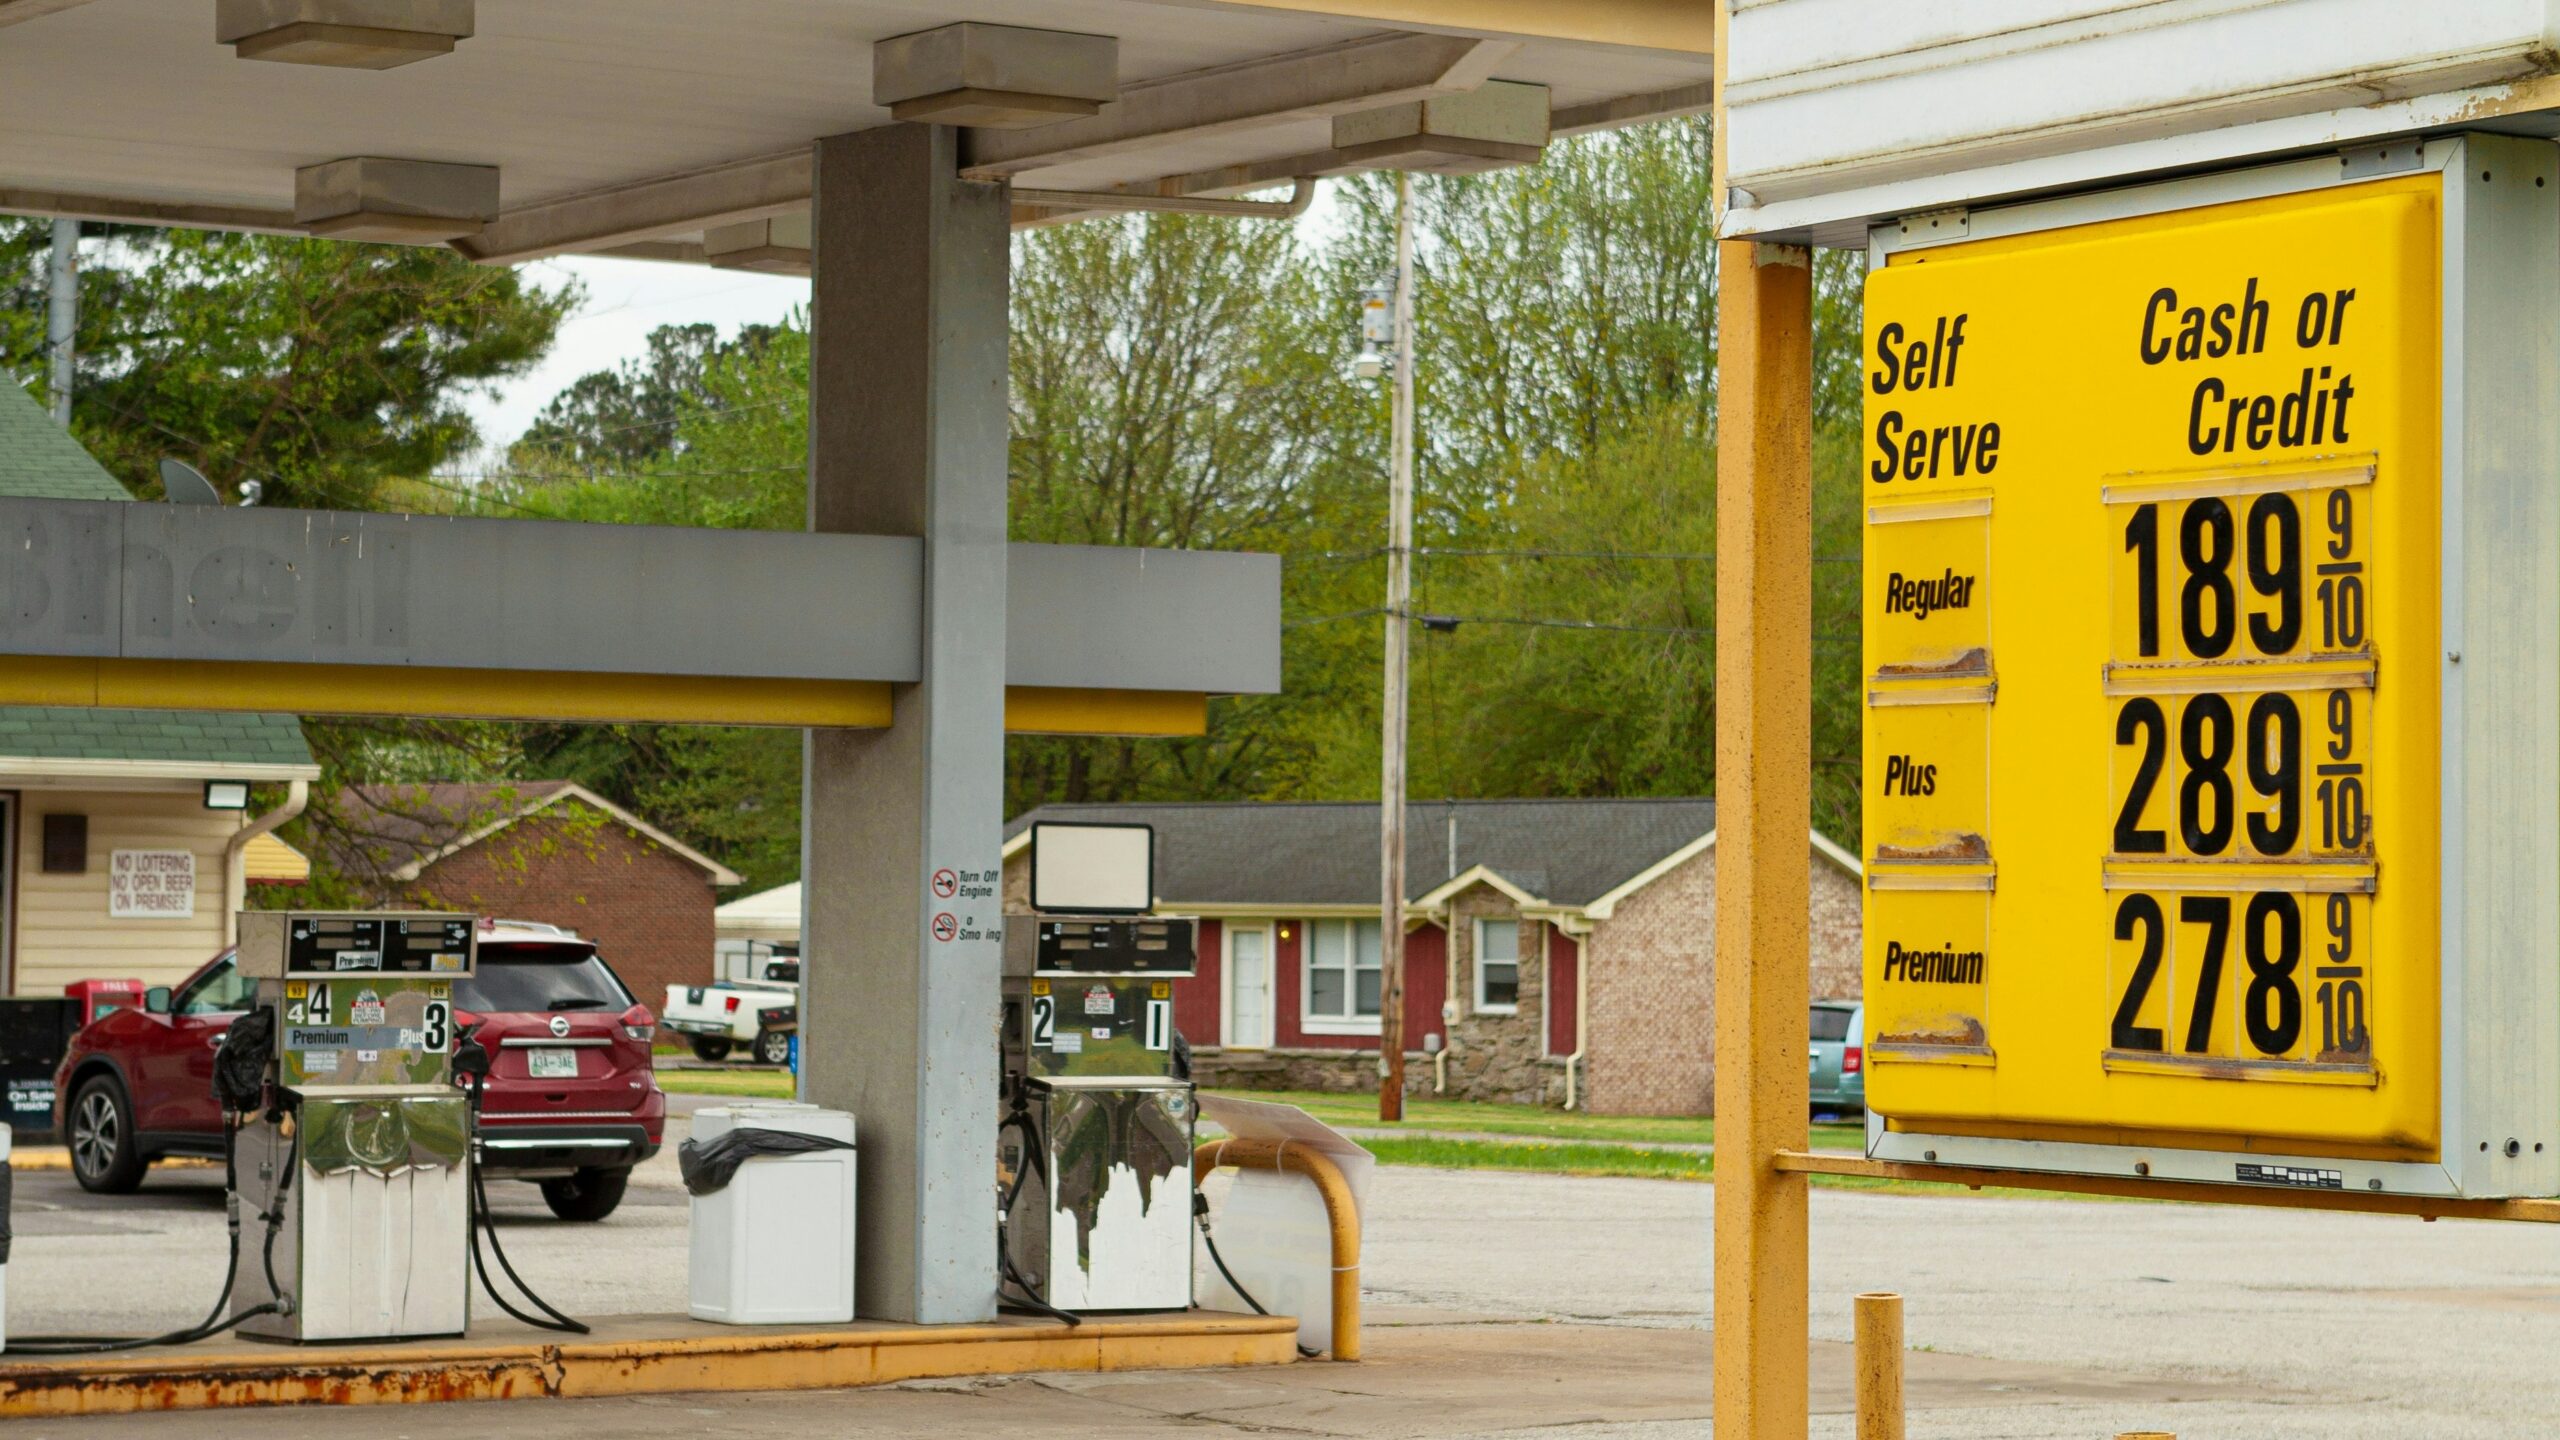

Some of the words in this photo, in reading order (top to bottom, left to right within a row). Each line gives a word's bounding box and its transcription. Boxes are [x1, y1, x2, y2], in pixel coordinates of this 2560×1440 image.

[2141, 278, 2270, 364] Cash
[2297, 289, 2355, 348] or
[1872, 314, 1967, 394] Self
[2189, 366, 2354, 455] Credit
[1871, 411, 2000, 483] Serve
[2327, 489, 2352, 559] 9
[1886, 568, 1974, 620] Regular
[2126, 492, 2302, 659] 189
[2317, 575, 2363, 648] 10
[2327, 689, 2352, 760] 9
[1885, 755, 1936, 796] Plus
[2114, 692, 2301, 856] 289
[2317, 776, 2363, 849] 10
[113, 874, 128, 891] NO
[132, 874, 160, 891] OPEN
[165, 874, 192, 891] BEER
[116, 855, 131, 872] NO
[136, 855, 190, 872] LOITERING
[960, 870, 979, 882] Turn
[984, 870, 998, 882] Off
[116, 894, 130, 910] ON
[960, 885, 992, 899] Engine
[2327, 892, 2351, 962] 9
[1884, 942, 1983, 984] Premium
[2111, 892, 2301, 1055] 278
[287, 1003, 304, 1024] 4
[309, 984, 329, 1023] 4
[434, 987, 444, 996] 89
[293, 1030, 348, 1044] Premium
[400, 1028, 424, 1043] Plus
[425, 1003, 446, 1050] 3
[1033, 999, 1052, 1043] 2
[2317, 980, 2363, 1052] 10
[13, 1102, 50, 1111] Inside
